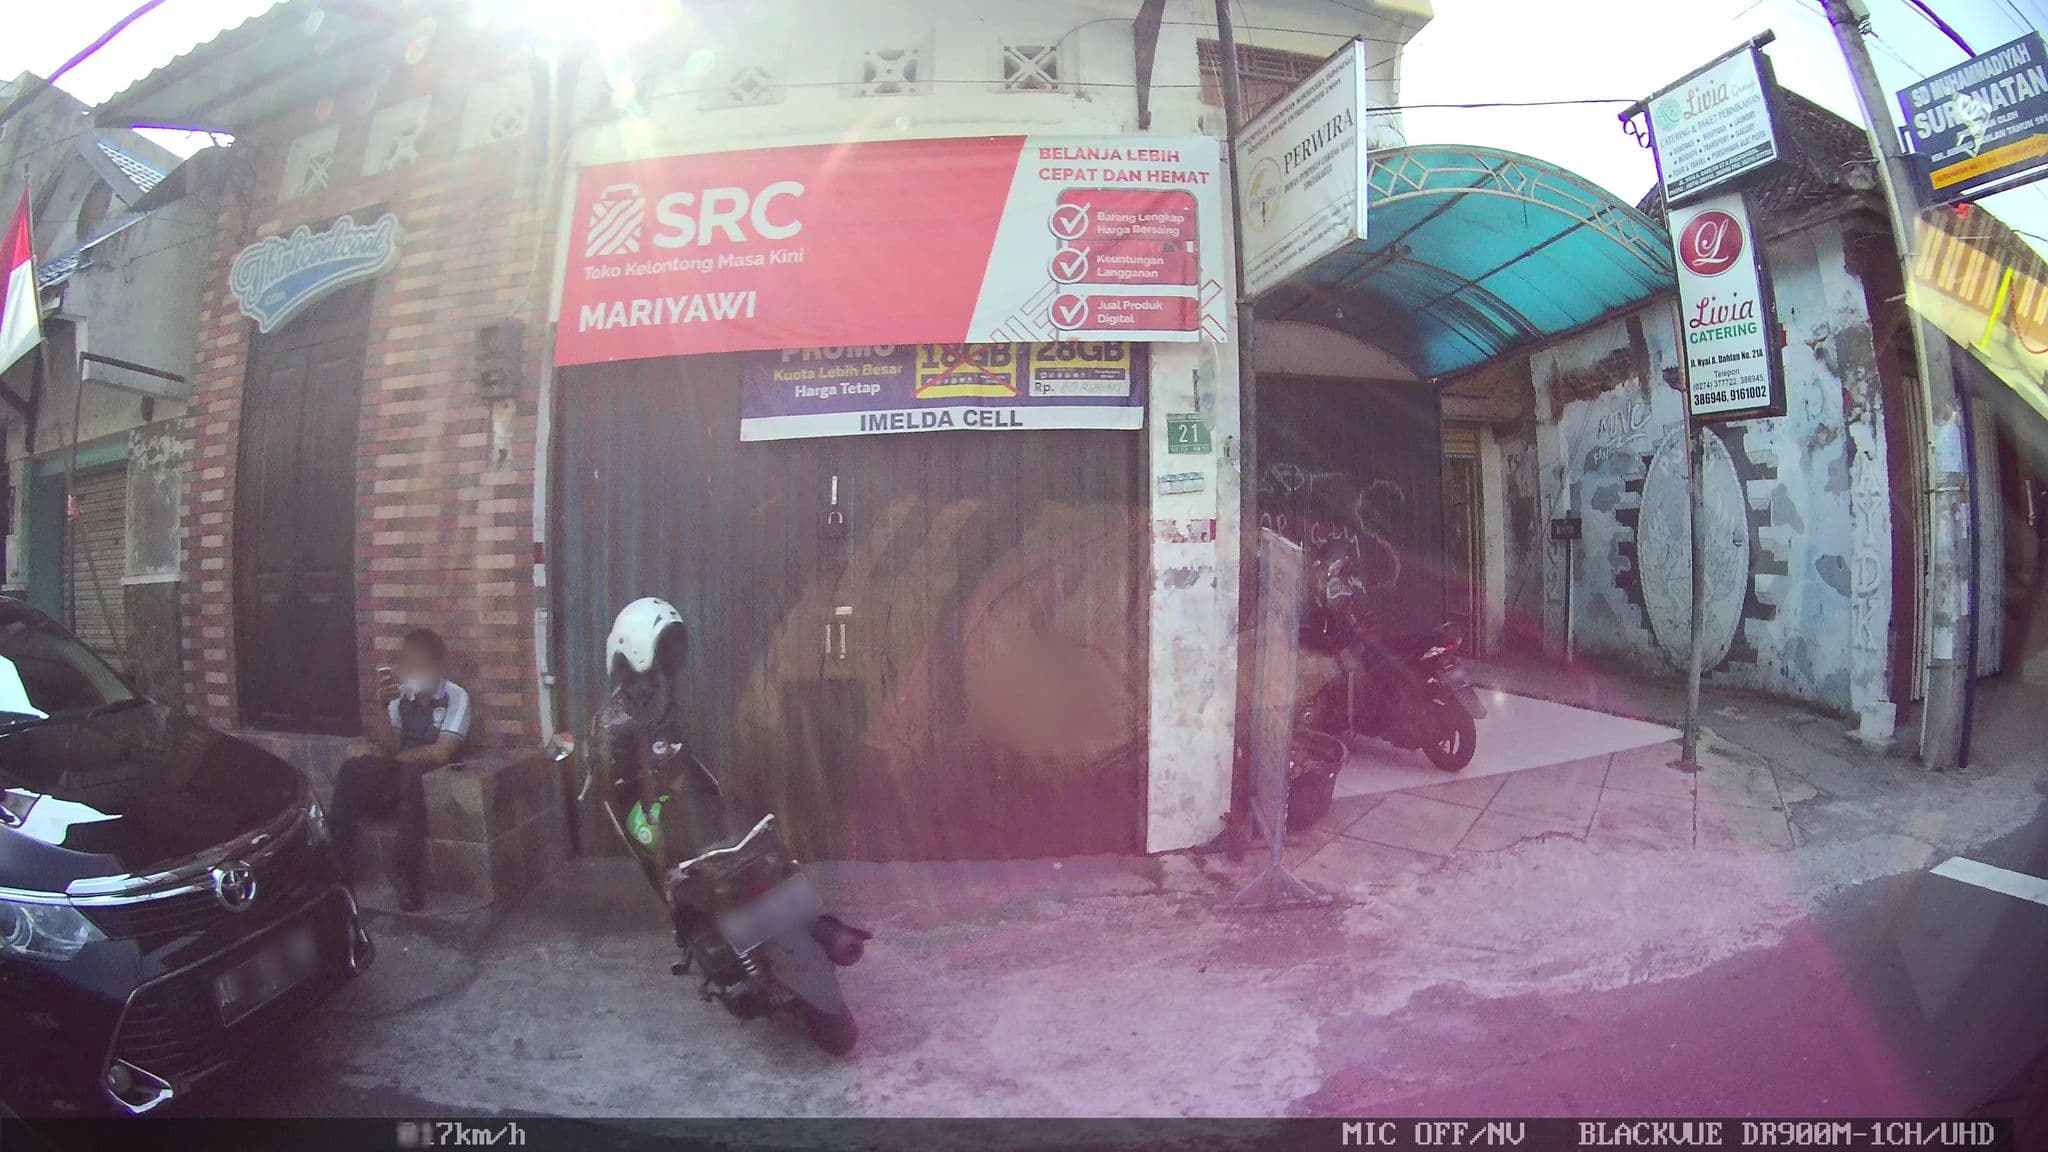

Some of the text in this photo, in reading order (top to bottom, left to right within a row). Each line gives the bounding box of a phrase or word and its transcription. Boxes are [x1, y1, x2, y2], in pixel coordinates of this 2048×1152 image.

[1929, 42, 2031, 100] MUHAMMADIYAH
[1684, 79, 1729, 121] Livia
[1914, 65, 2048, 139] SURNATAN
[1283, 107, 1354, 174] PERWIRA
[1039, 147, 1180, 163] BELANJA LEBIH
[1039, 168, 1210, 184] CEPAT DAN HEMAT
[653, 181, 805, 249] SRC
[1097, 212, 1184, 225] Barang Lengkap
[1097, 225, 1180, 237] Harga Bersaing
[585, 247, 805, 281] Toko Kelontong Masa Kini
[1096, 255, 1164, 266] Keuntungan
[1096, 267, 1159, 279] Langganan
[578, 290, 757, 333] MARIYAWI
[1096, 301, 1163, 311] Jual Produk
[1689, 292, 1754, 329] Livia
[1096, 313, 1136, 325] Digital
[1690, 322, 1758, 345] CATERING
[773, 363, 903, 381] Kuota Lebih Besar
[795, 383, 881, 399] Harga Tetap
[1730, 385, 1768, 401] 9161002
[859, 409, 1024, 432] IMELDA CELL
[1178, 423, 1199, 443] 21
